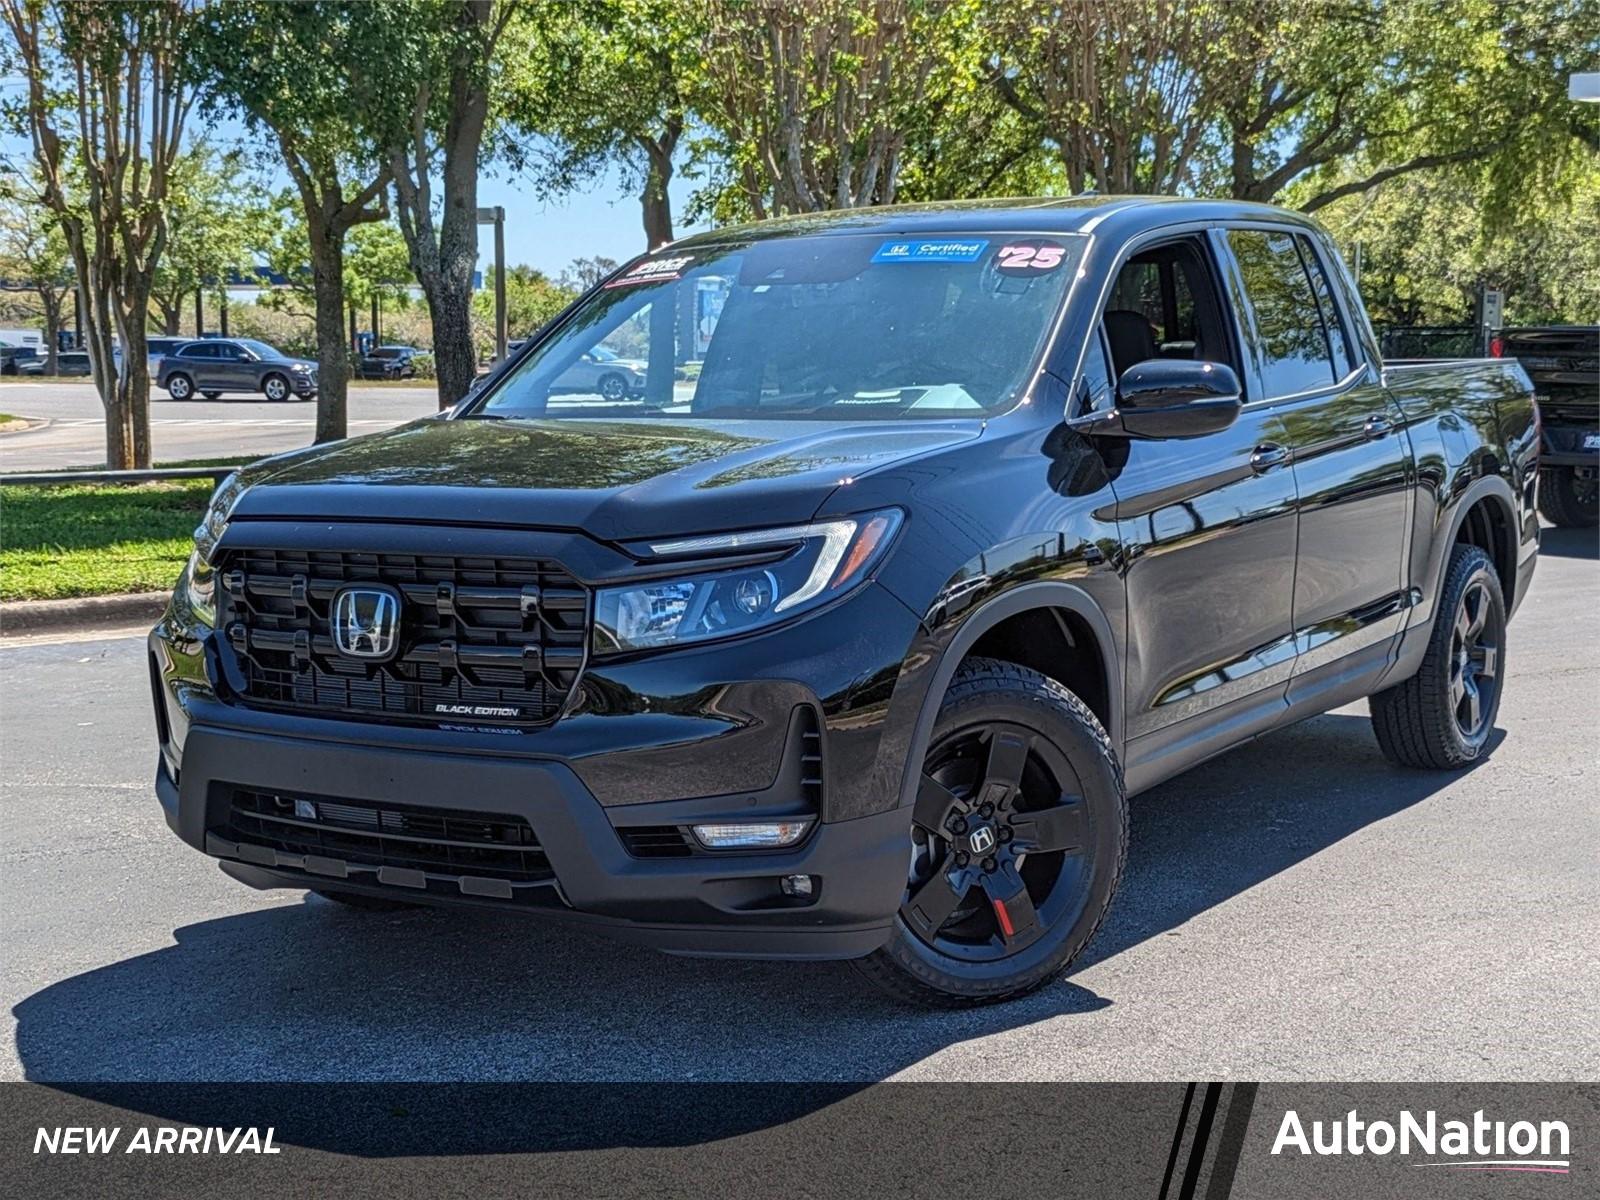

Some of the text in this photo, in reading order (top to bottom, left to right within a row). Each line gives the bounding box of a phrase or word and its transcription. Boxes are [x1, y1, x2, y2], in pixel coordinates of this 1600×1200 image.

[920, 244, 979, 253] Certified
[998, 246, 1066, 269] '25
[435, 704, 519, 716] BLACK EDITION
